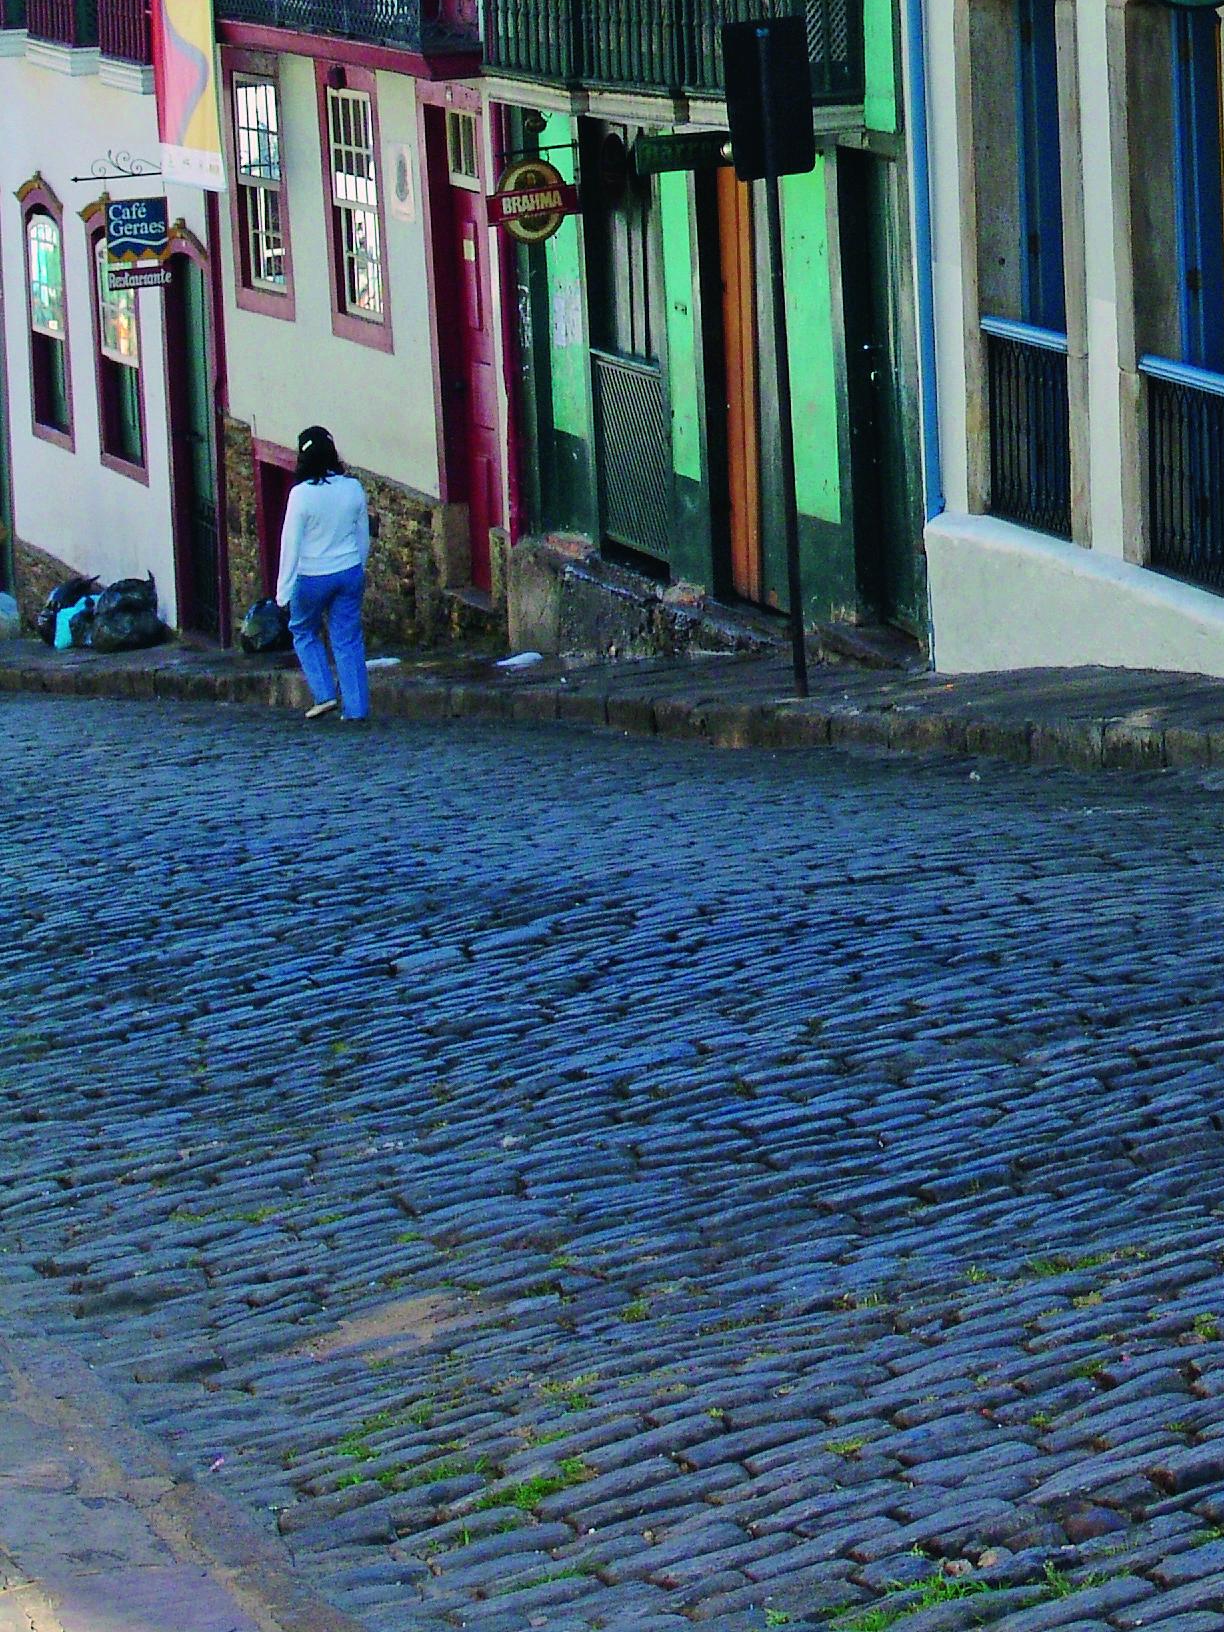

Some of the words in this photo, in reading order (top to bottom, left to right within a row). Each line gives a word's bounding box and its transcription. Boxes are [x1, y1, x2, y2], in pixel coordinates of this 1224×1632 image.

[108, 202, 148, 221] Café
[502, 190, 564, 215] BRAHMA
[109, 220, 166, 237] Geraes
